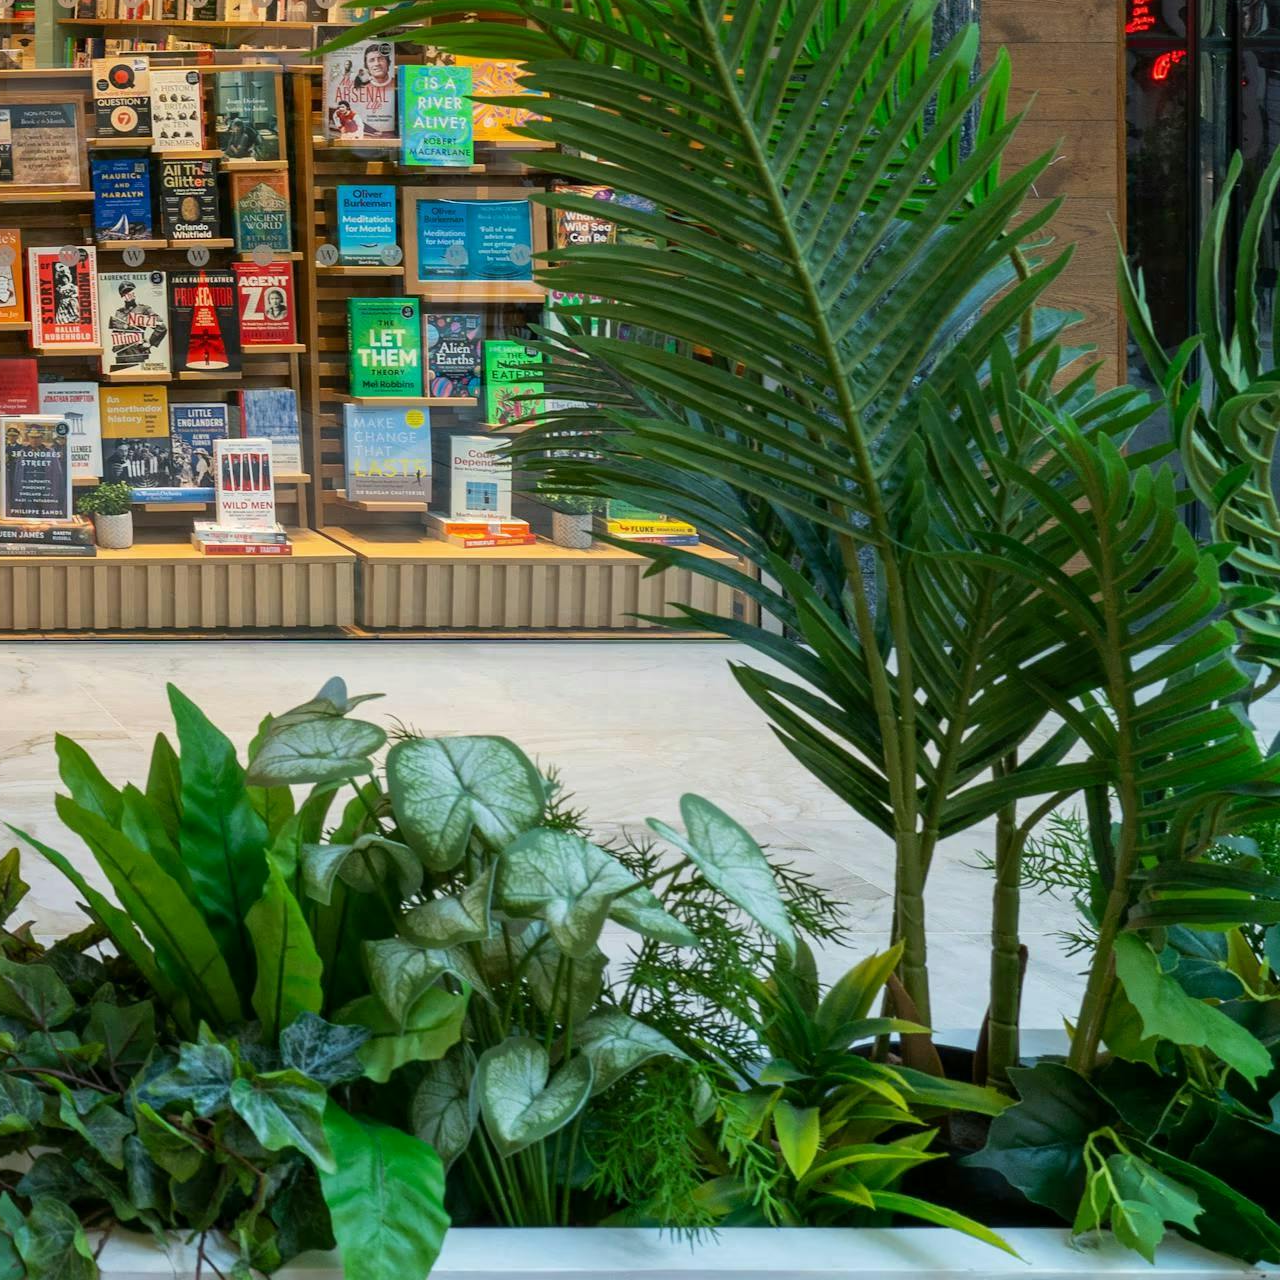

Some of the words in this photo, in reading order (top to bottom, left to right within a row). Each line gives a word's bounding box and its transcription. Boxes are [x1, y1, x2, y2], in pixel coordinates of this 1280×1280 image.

[424, 76, 439, 89] IS
[444, 76, 456, 89] A
[335, 86, 389, 103] ARSENAL
[97, 98, 141, 107] QUESTION
[142, 97, 149, 105] 7
[418, 96, 462, 109] RIVER
[413, 116, 467, 129] ALIVE?
[423, 137, 457, 145] ROBERT
[5, 144, 10, 152] 7
[409, 147, 471, 157] MACFARLANE
[163, 164, 184, 176] All
[163, 176, 215, 188] Glitters
[352, 188, 383, 199] Oliver
[343, 198, 392, 208] Burkeman
[431, 207, 457, 216] Oliver
[242, 214, 285, 222] ANCIENT
[342, 214, 394, 224] Meditations
[424, 215, 465, 224] Burkeman
[174, 223, 209, 232] Orlando
[245, 221, 282, 230] WORLD
[345, 224, 359, 233] for
[359, 224, 392, 233] Mortals
[565, 221, 589, 232] Wild
[591, 221, 612, 233] Sea
[172, 231, 213, 239] Whitfield
[423, 229, 466, 238] Meditations
[570, 233, 591, 243] Can
[593, 233, 607, 243] Be
[425, 237, 436, 246] for
[437, 237, 465, 246] Mortals
[171, 276, 188, 284] JACK
[189, 276, 235, 284] FAIRWEATHER
[238, 275, 289, 287] AGENT
[174, 287, 233, 307] PROSECUTOR
[127, 313, 157, 328] Nazi
[44, 332, 91, 341] RUBENHOLD
[369, 328, 406, 347] LET
[439, 342, 472, 354] Alien
[357, 348, 417, 367] THEM
[436, 353, 475, 365] Earths
[362, 380, 379, 388] Mel
[380, 380, 415, 388] Robbins
[106, 395, 120, 404] An
[107, 405, 162, 414] unorthodox
[187, 409, 213, 418] LITTLE
[107, 415, 143, 424] history.
[177, 419, 224, 428] ENGLANDERS
[353, 417, 394, 429] MAKE
[354, 431, 417, 443] CHANGE
[23, 450, 62, 459] LONDRES
[354, 445, 392, 457] THAT
[21, 459, 52, 467] STREET
[222, 501, 248, 510] WILD
[250, 501, 273, 510] MEN
[41, 508, 64, 516] SANDS
[630, 525, 654, 533] FLUKE
[19, 530, 45, 539] JAMES
